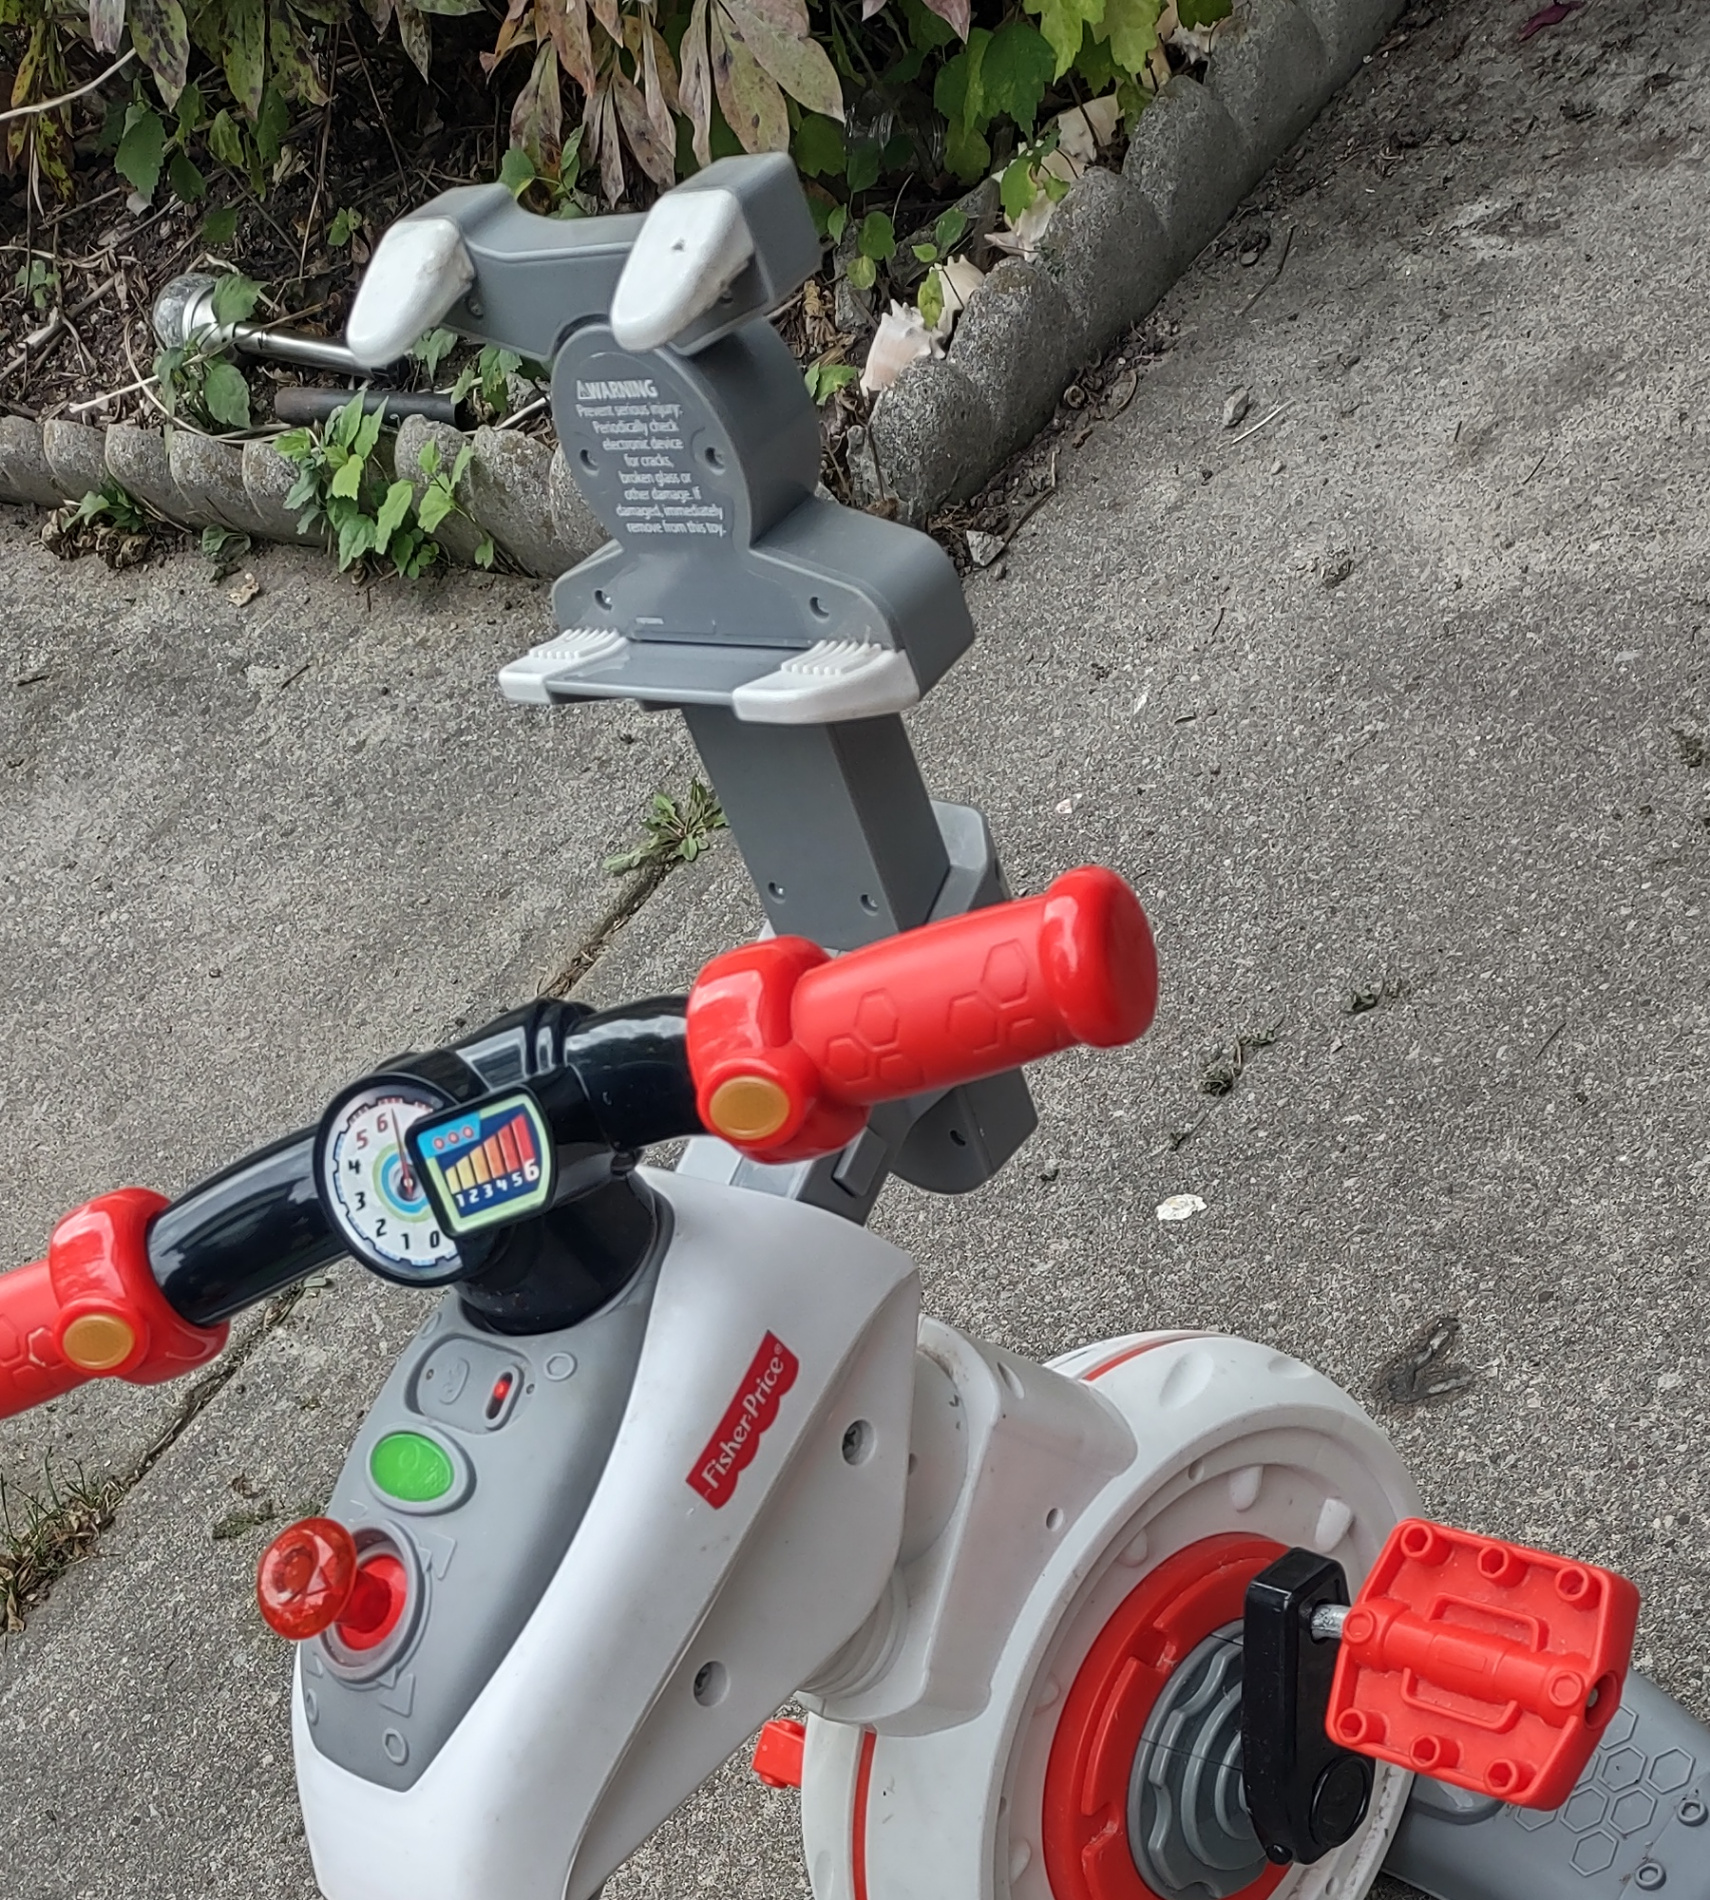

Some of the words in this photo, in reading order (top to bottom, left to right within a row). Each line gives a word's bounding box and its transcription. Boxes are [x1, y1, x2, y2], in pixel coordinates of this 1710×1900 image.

[585, 379, 659, 400] WARNING
[576, 403, 615, 417] Prevent
[614, 402, 650, 416] serious
[592, 419, 649, 437] Periodically
[649, 419, 680, 432] check
[602, 437, 651, 451] electronic
[650, 437, 684, 449] device
[624, 453, 639, 467] for
[641, 453, 674, 468] cracks,
[618, 470, 655, 484] broken
[655, 470, 680, 487] glass
[680, 472, 692, 483] or
[624, 487, 650, 500] other
[651, 487, 693, 503] damage.
[692, 486, 702, 500] If
[616, 503, 664, 520] damaged,
[661, 503, 723, 521] immediately
[626, 522, 663, 533] remove
[661, 520, 688, 533] from
[686, 520, 707, 533] this
[705, 522, 727, 537] toy.
[376, 1113, 389, 1133] 6
[356, 1129, 369, 1150] 5
[348, 1159, 361, 1174] 4
[456, 1193, 465, 1207] 1
[468, 1188, 480, 1204] 2
[482, 1183, 493, 1198] 3
[496, 1178, 507, 1192] 4
[511, 1172, 523, 1187] 5
[524, 1158, 541, 1182] 6
[355, 1191, 366, 1211] 3
[375, 1218, 387, 1237] 2
[401, 1233, 411, 1250] 1
[429, 1230, 440, 1249] 0
